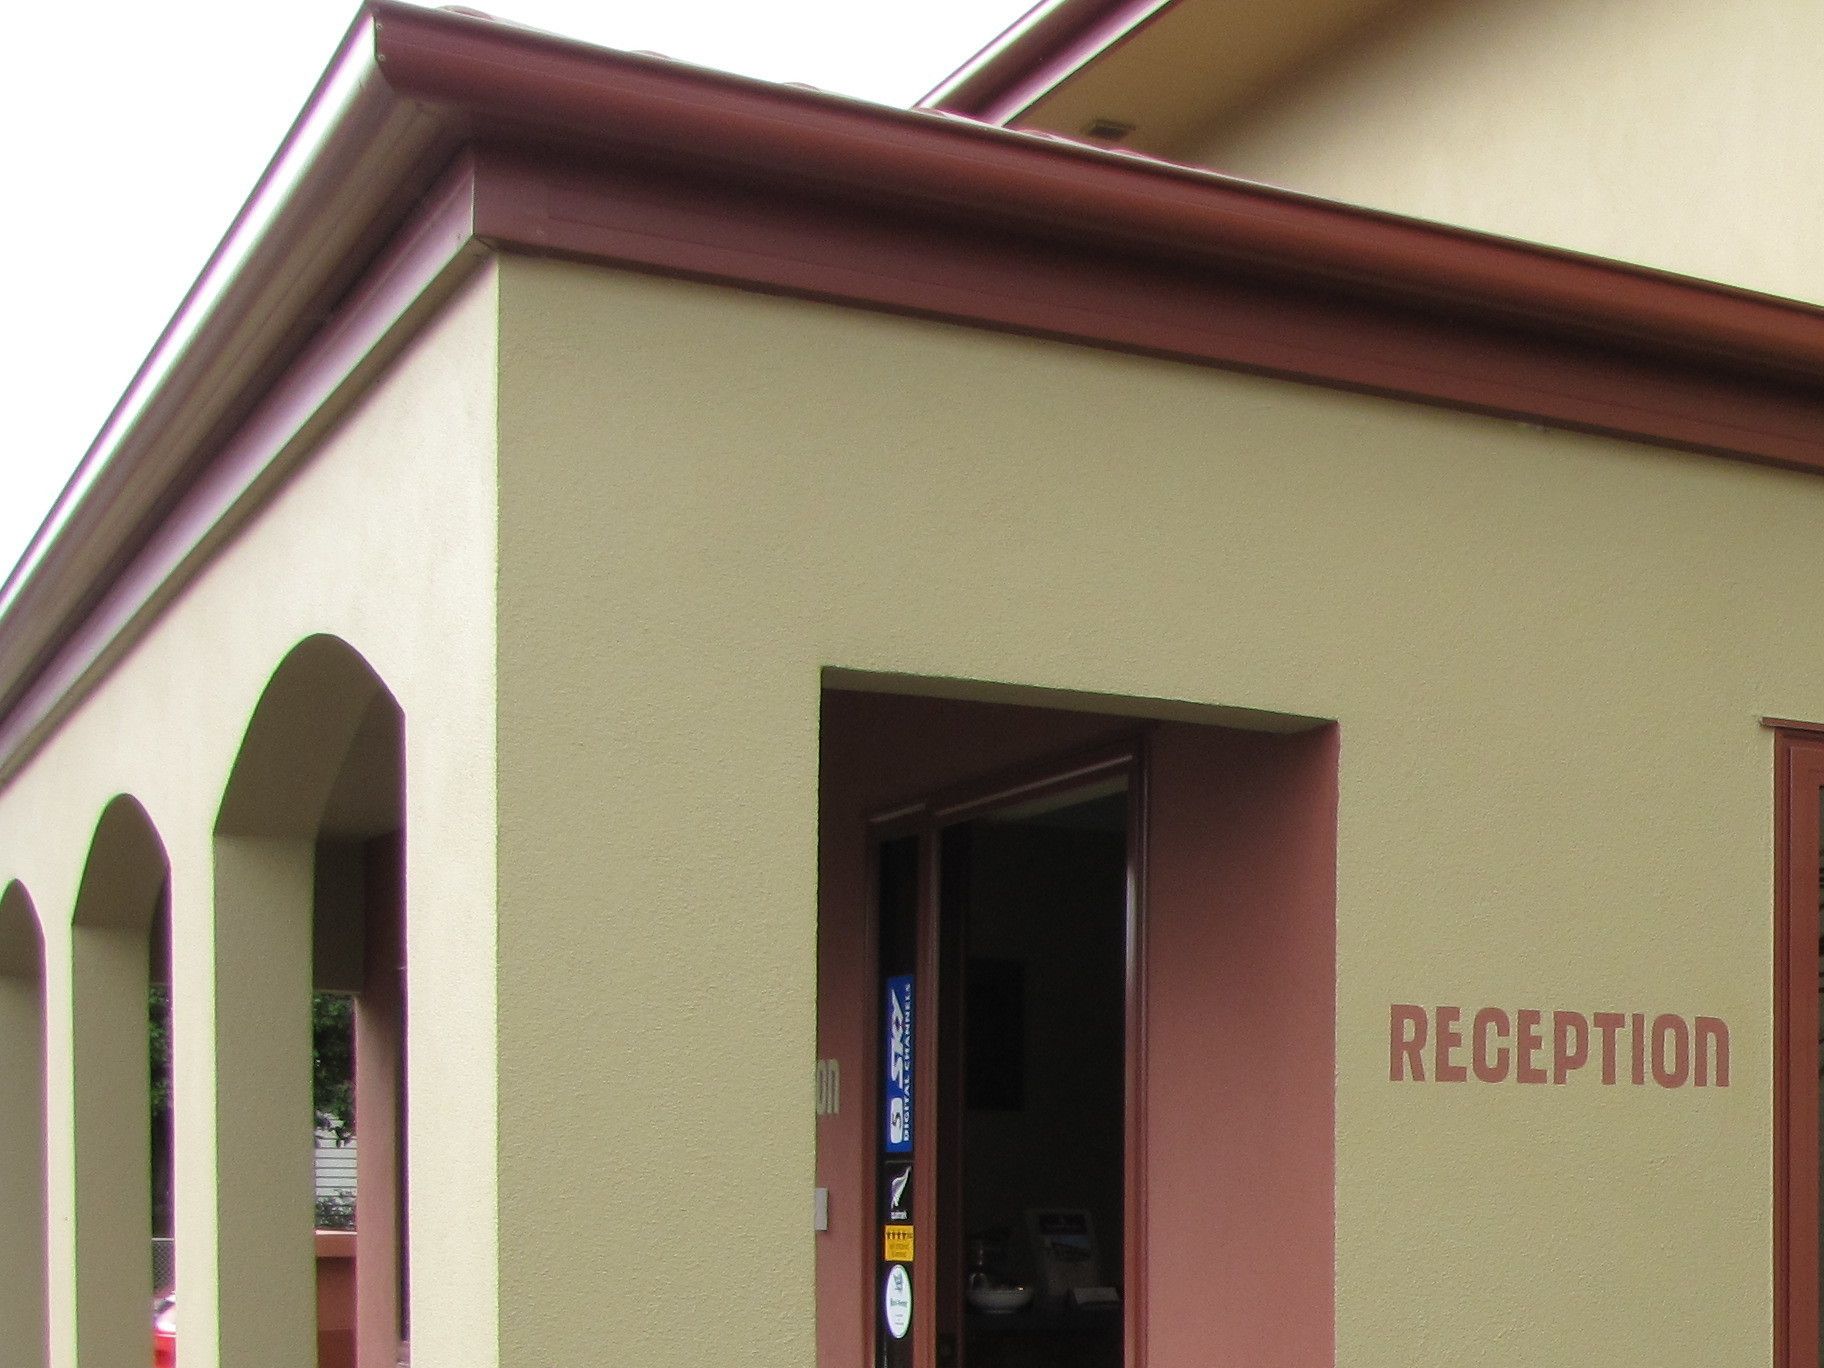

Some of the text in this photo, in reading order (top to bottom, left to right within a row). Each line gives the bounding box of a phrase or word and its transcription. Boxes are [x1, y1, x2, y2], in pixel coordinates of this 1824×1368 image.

[891, 989, 904, 1089] SKY
[903, 983, 912, 1142] DIGITAL CHANNELS
[1389, 1003, 1730, 1089] RECEPTION
